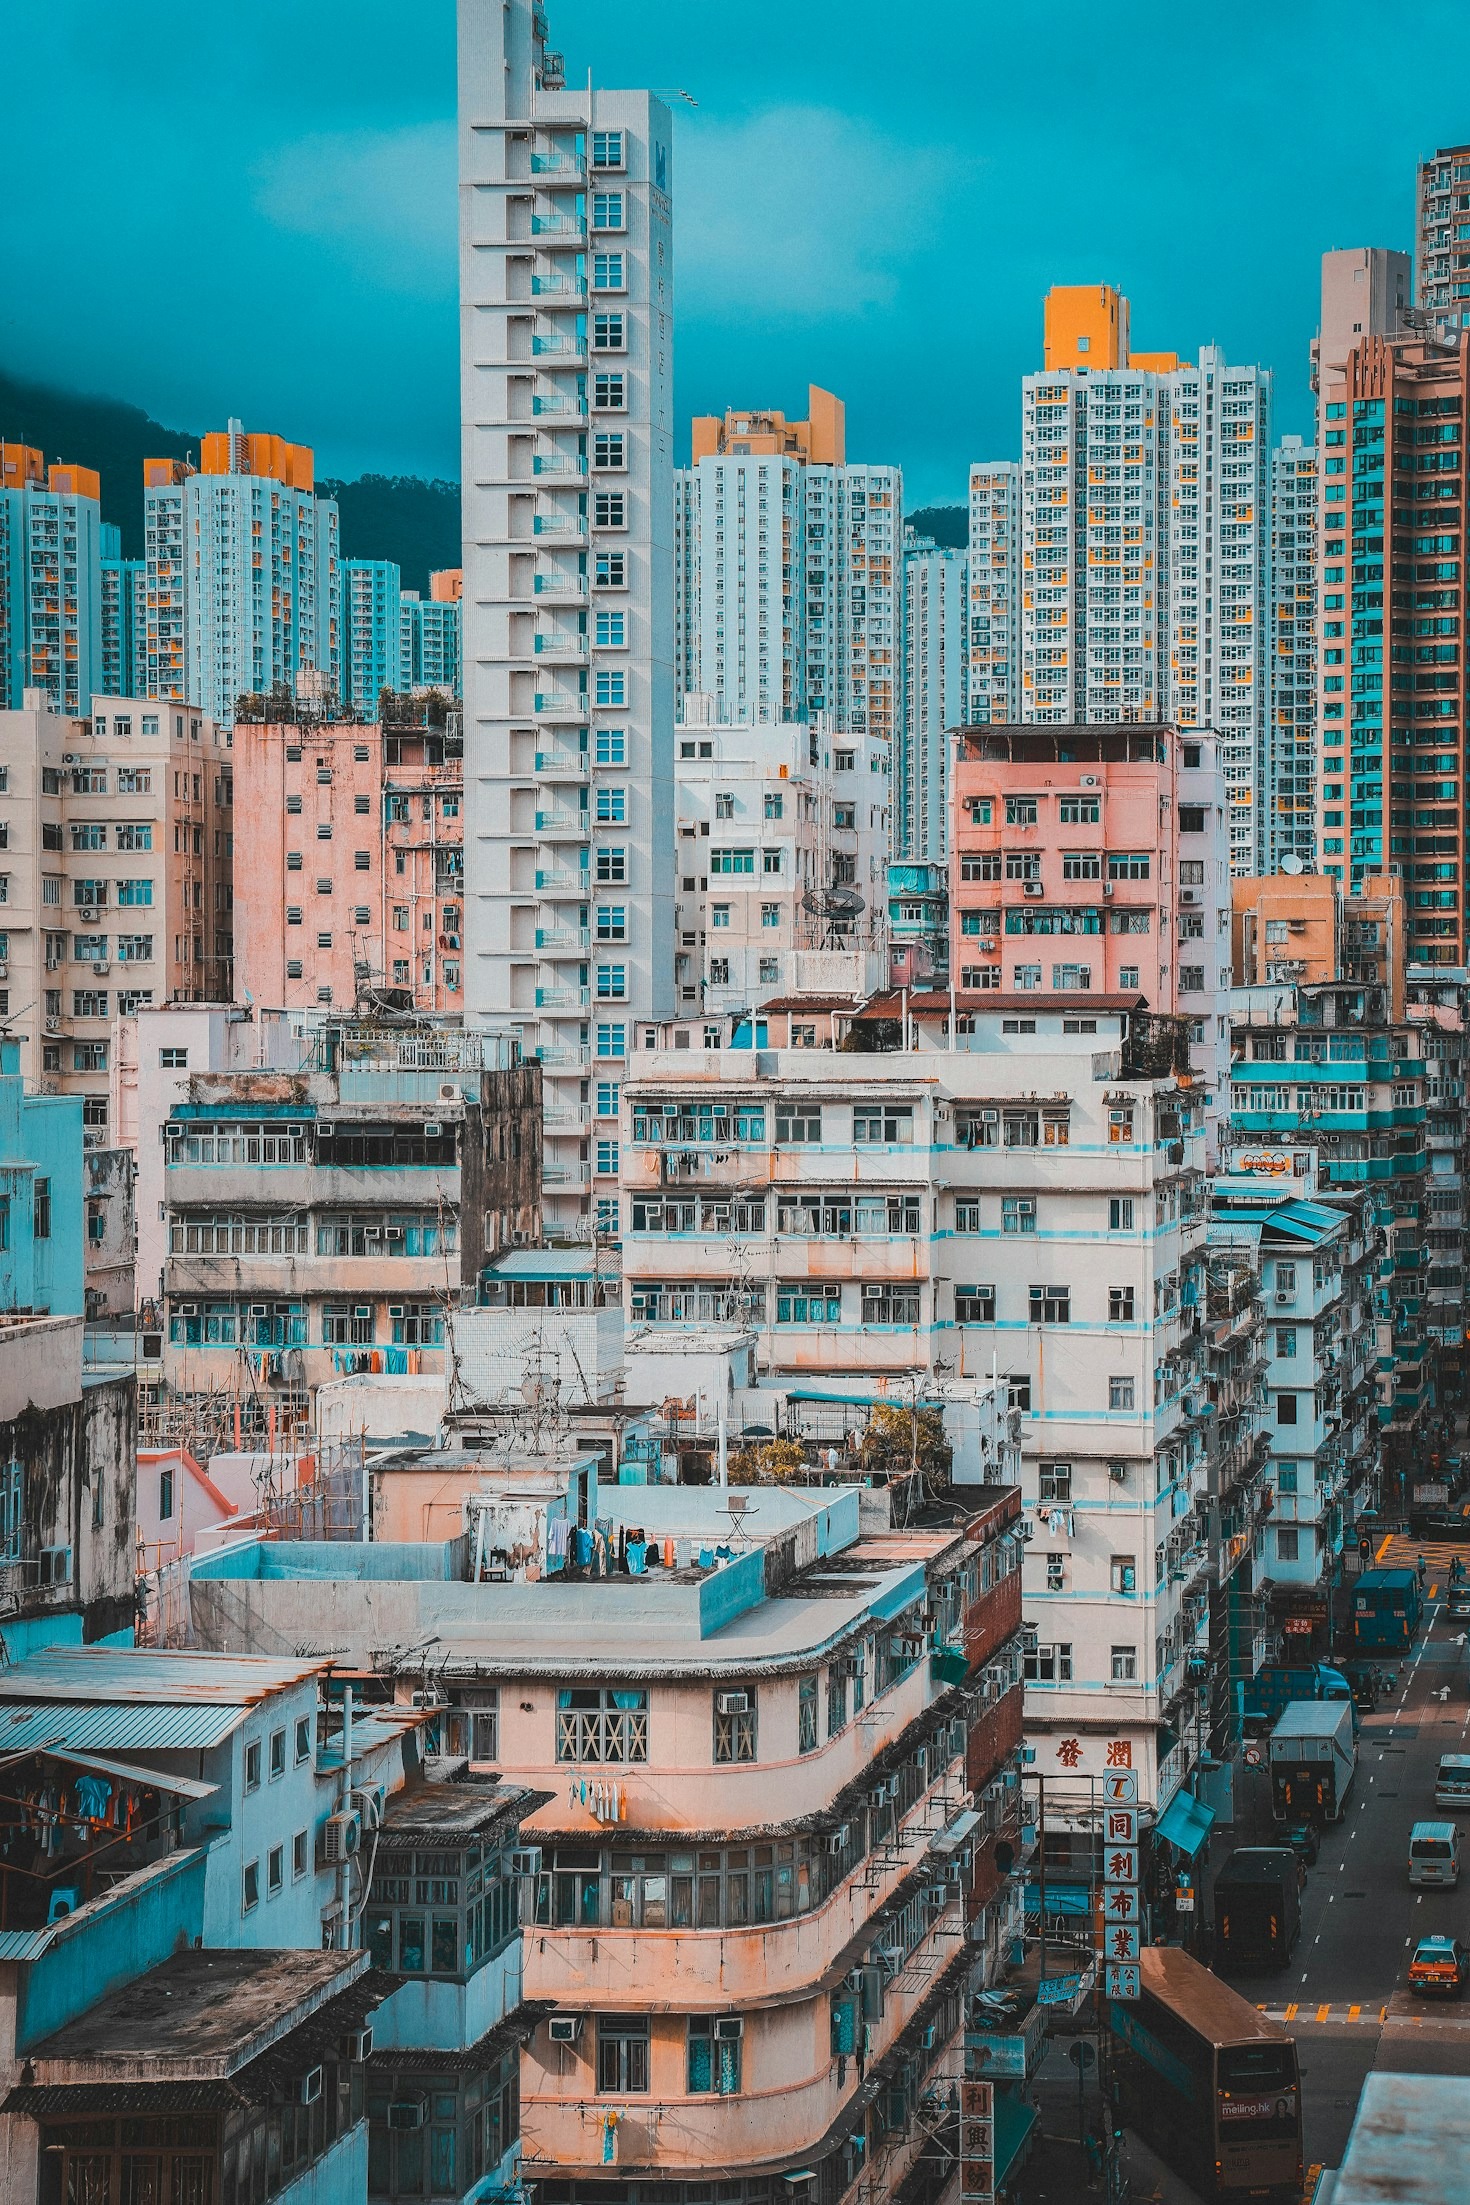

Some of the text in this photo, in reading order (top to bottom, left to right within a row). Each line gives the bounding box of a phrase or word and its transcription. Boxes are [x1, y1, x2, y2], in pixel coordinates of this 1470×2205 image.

[1108, 1813, 1136, 1997] 同利布業 有限公司
[965, 2087, 989, 2205] 利興紡
[1222, 2102, 1271, 2116] meiling.hk
